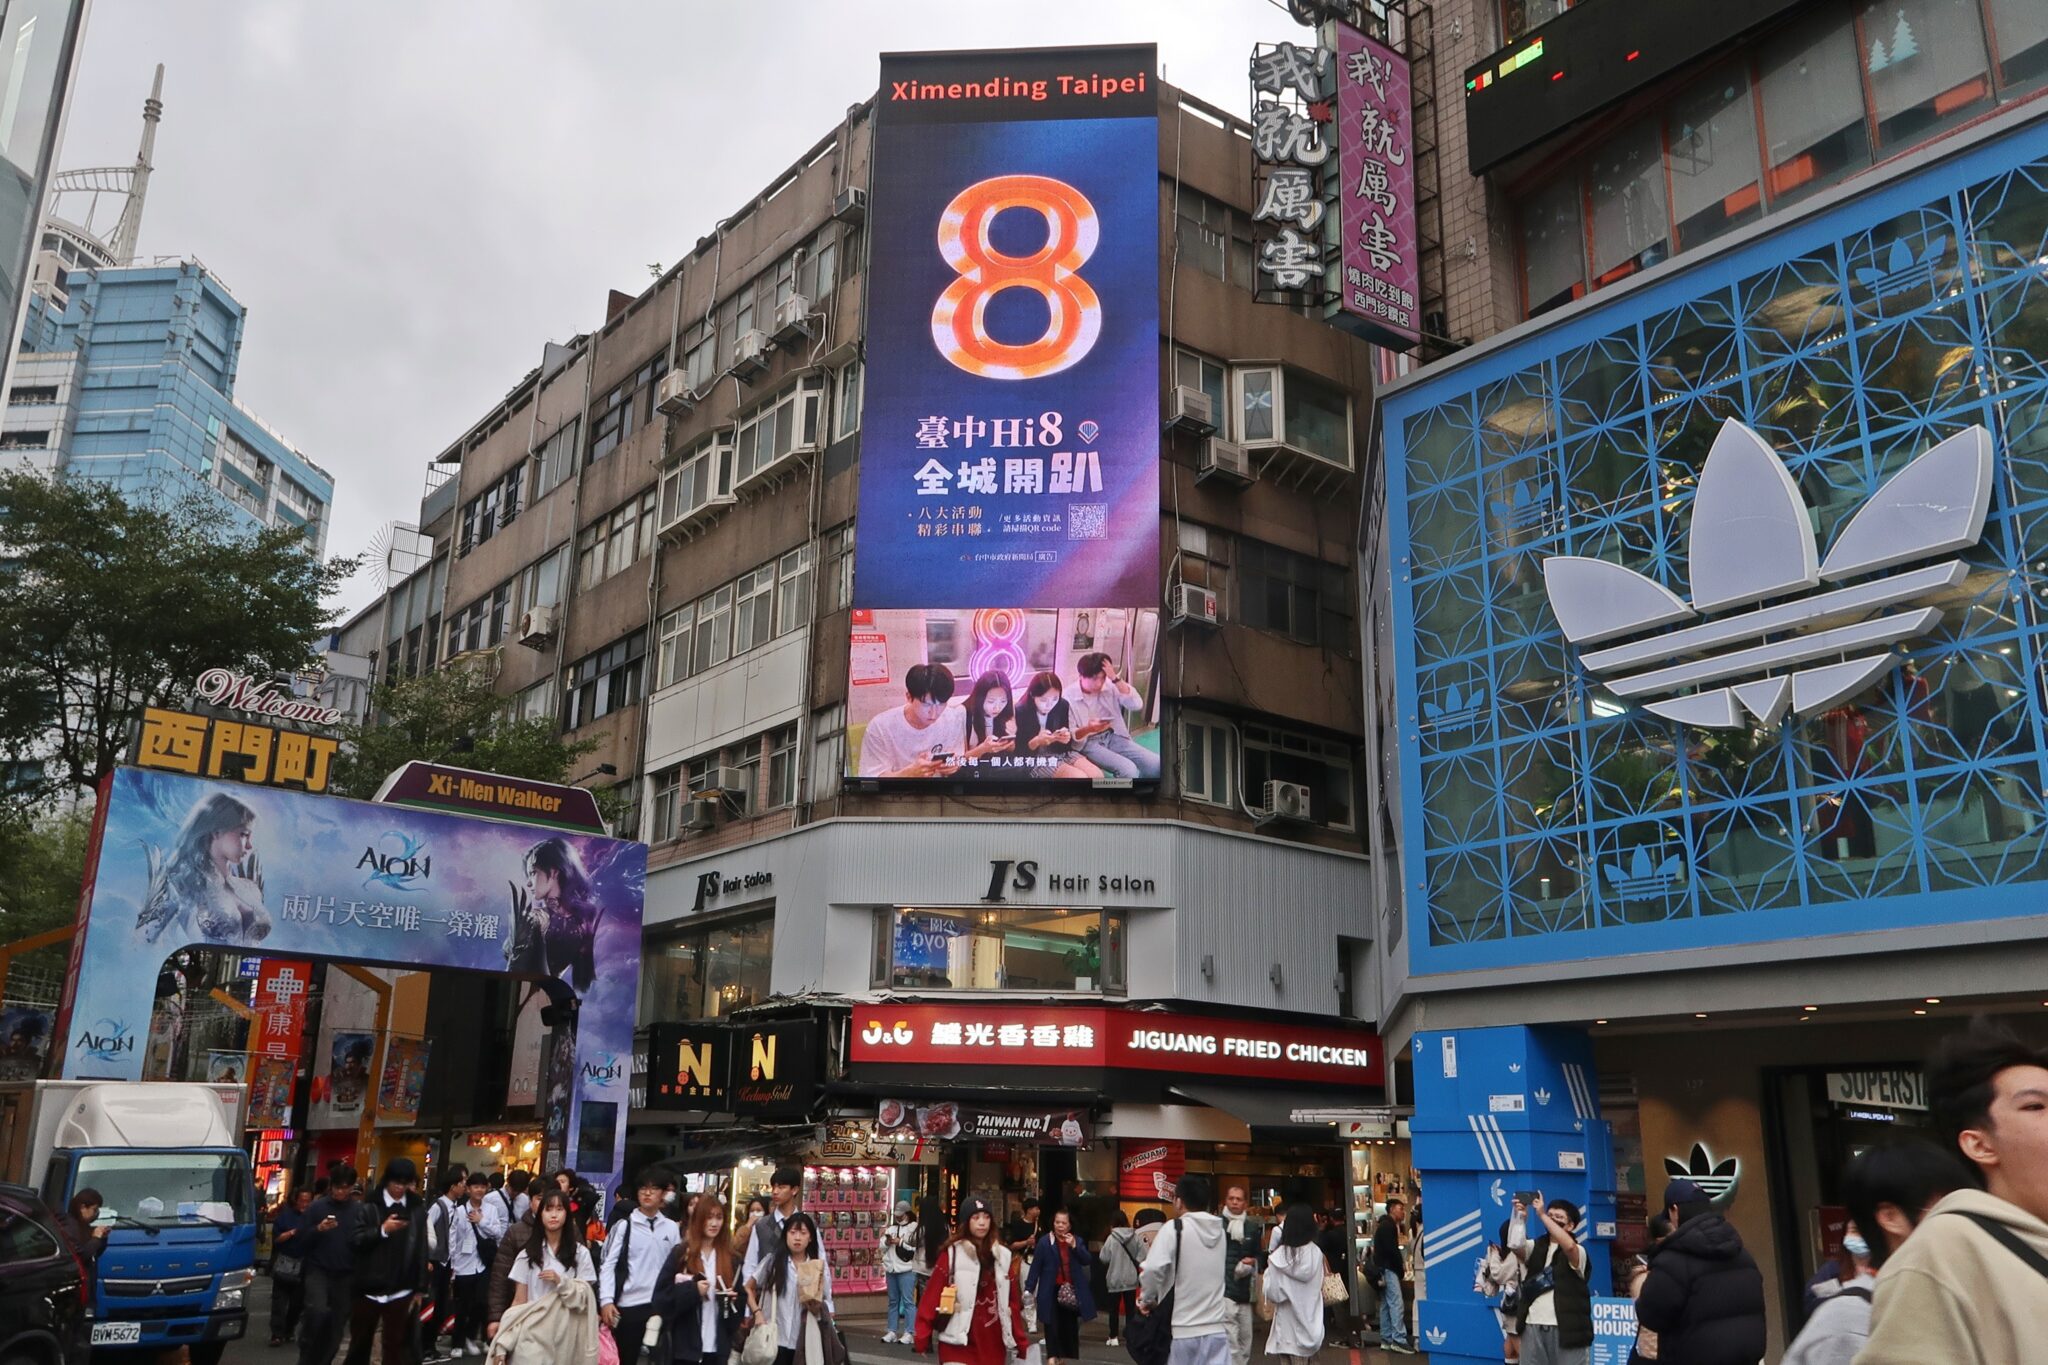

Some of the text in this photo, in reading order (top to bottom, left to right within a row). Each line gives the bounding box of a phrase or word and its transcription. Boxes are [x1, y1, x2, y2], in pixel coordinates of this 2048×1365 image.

[891, 73, 1145, 101] Ximending Taipei
[931, 175, 1101, 379] 8
[1347, 266, 1414, 310] 燒肉吃到飽
[915, 411, 1063, 450] 臺中Hi8
[913, 451, 1104, 496] 全城開趴
[919, 506, 982, 520] 八大活動
[917, 523, 982, 537] 精彩串聯
[1041, 524, 1062, 532] code
[196, 668, 341, 725] Welcome
[137, 707, 338, 793] 西門町
[945, 756, 1058, 767] 然後每一個人都有機會
[427, 773, 562, 813] Xi-Men Walker
[355, 846, 431, 881] AION
[722, 875, 742, 894] Hair
[743, 870, 772, 891] Salon
[1049, 874, 1089, 891] Hair
[1099, 874, 1155, 892] Salon
[280, 892, 501, 943] 兩片天空唯一榮耀
[75, 1031, 134, 1054] AION
[862, 1020, 913, 1045] J&G
[1128, 1030, 1367, 1067] JIGUANG FRIED CHICKEN
[580, 1062, 621, 1079] AION
[770, 1084, 793, 1100] Gold
[976, 1113, 1051, 1132] TAIWAN NO.1
[976, 1127, 1036, 1138] FRIED CHICKEN
[1593, 1320, 1639, 1337] HOURS
